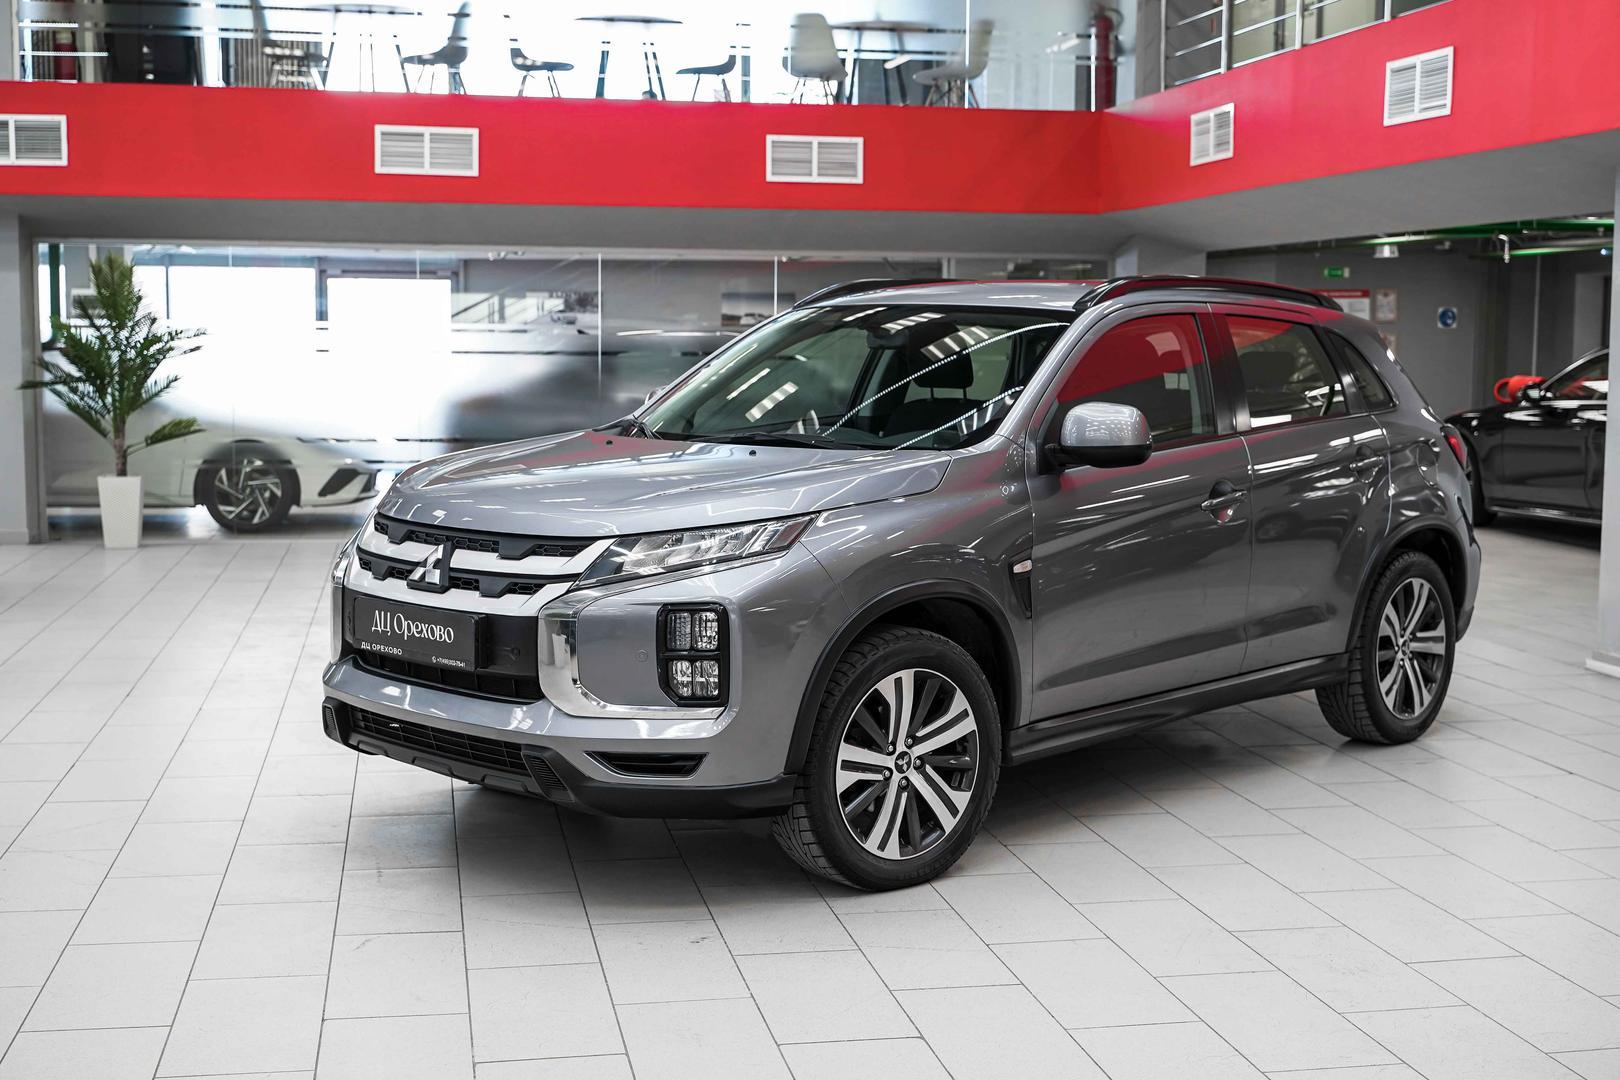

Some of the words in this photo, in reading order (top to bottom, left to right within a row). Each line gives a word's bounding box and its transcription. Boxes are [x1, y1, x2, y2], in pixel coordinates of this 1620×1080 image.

[372, 610, 391, 636] ДЦ
[394, 613, 454, 643] Орехово
[361, 641, 371, 650] ДЦ
[372, 643, 402, 655] ОРЕХОВО
